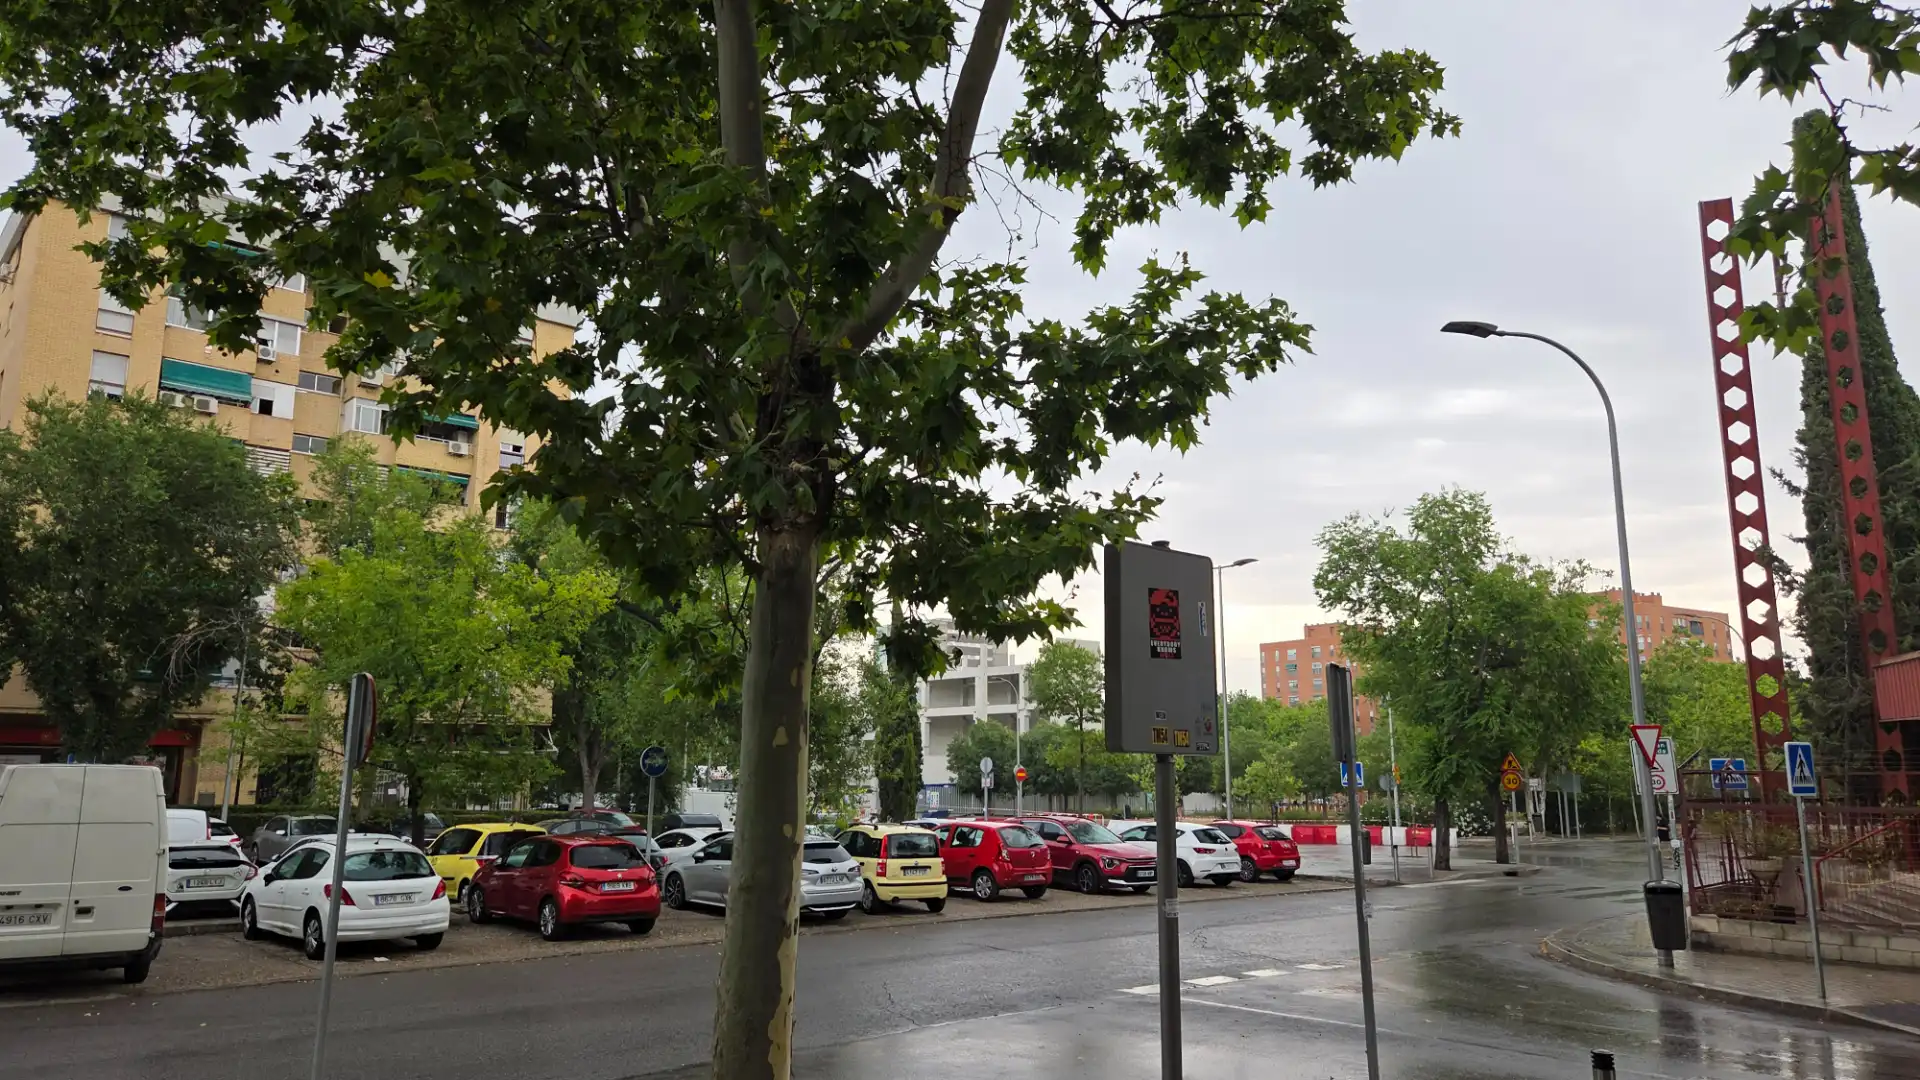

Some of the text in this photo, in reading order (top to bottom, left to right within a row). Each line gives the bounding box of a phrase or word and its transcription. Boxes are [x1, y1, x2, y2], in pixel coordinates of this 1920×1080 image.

[1505, 777, 1518, 786] 30
[0, 914, 49, 925] 4916 CXV
